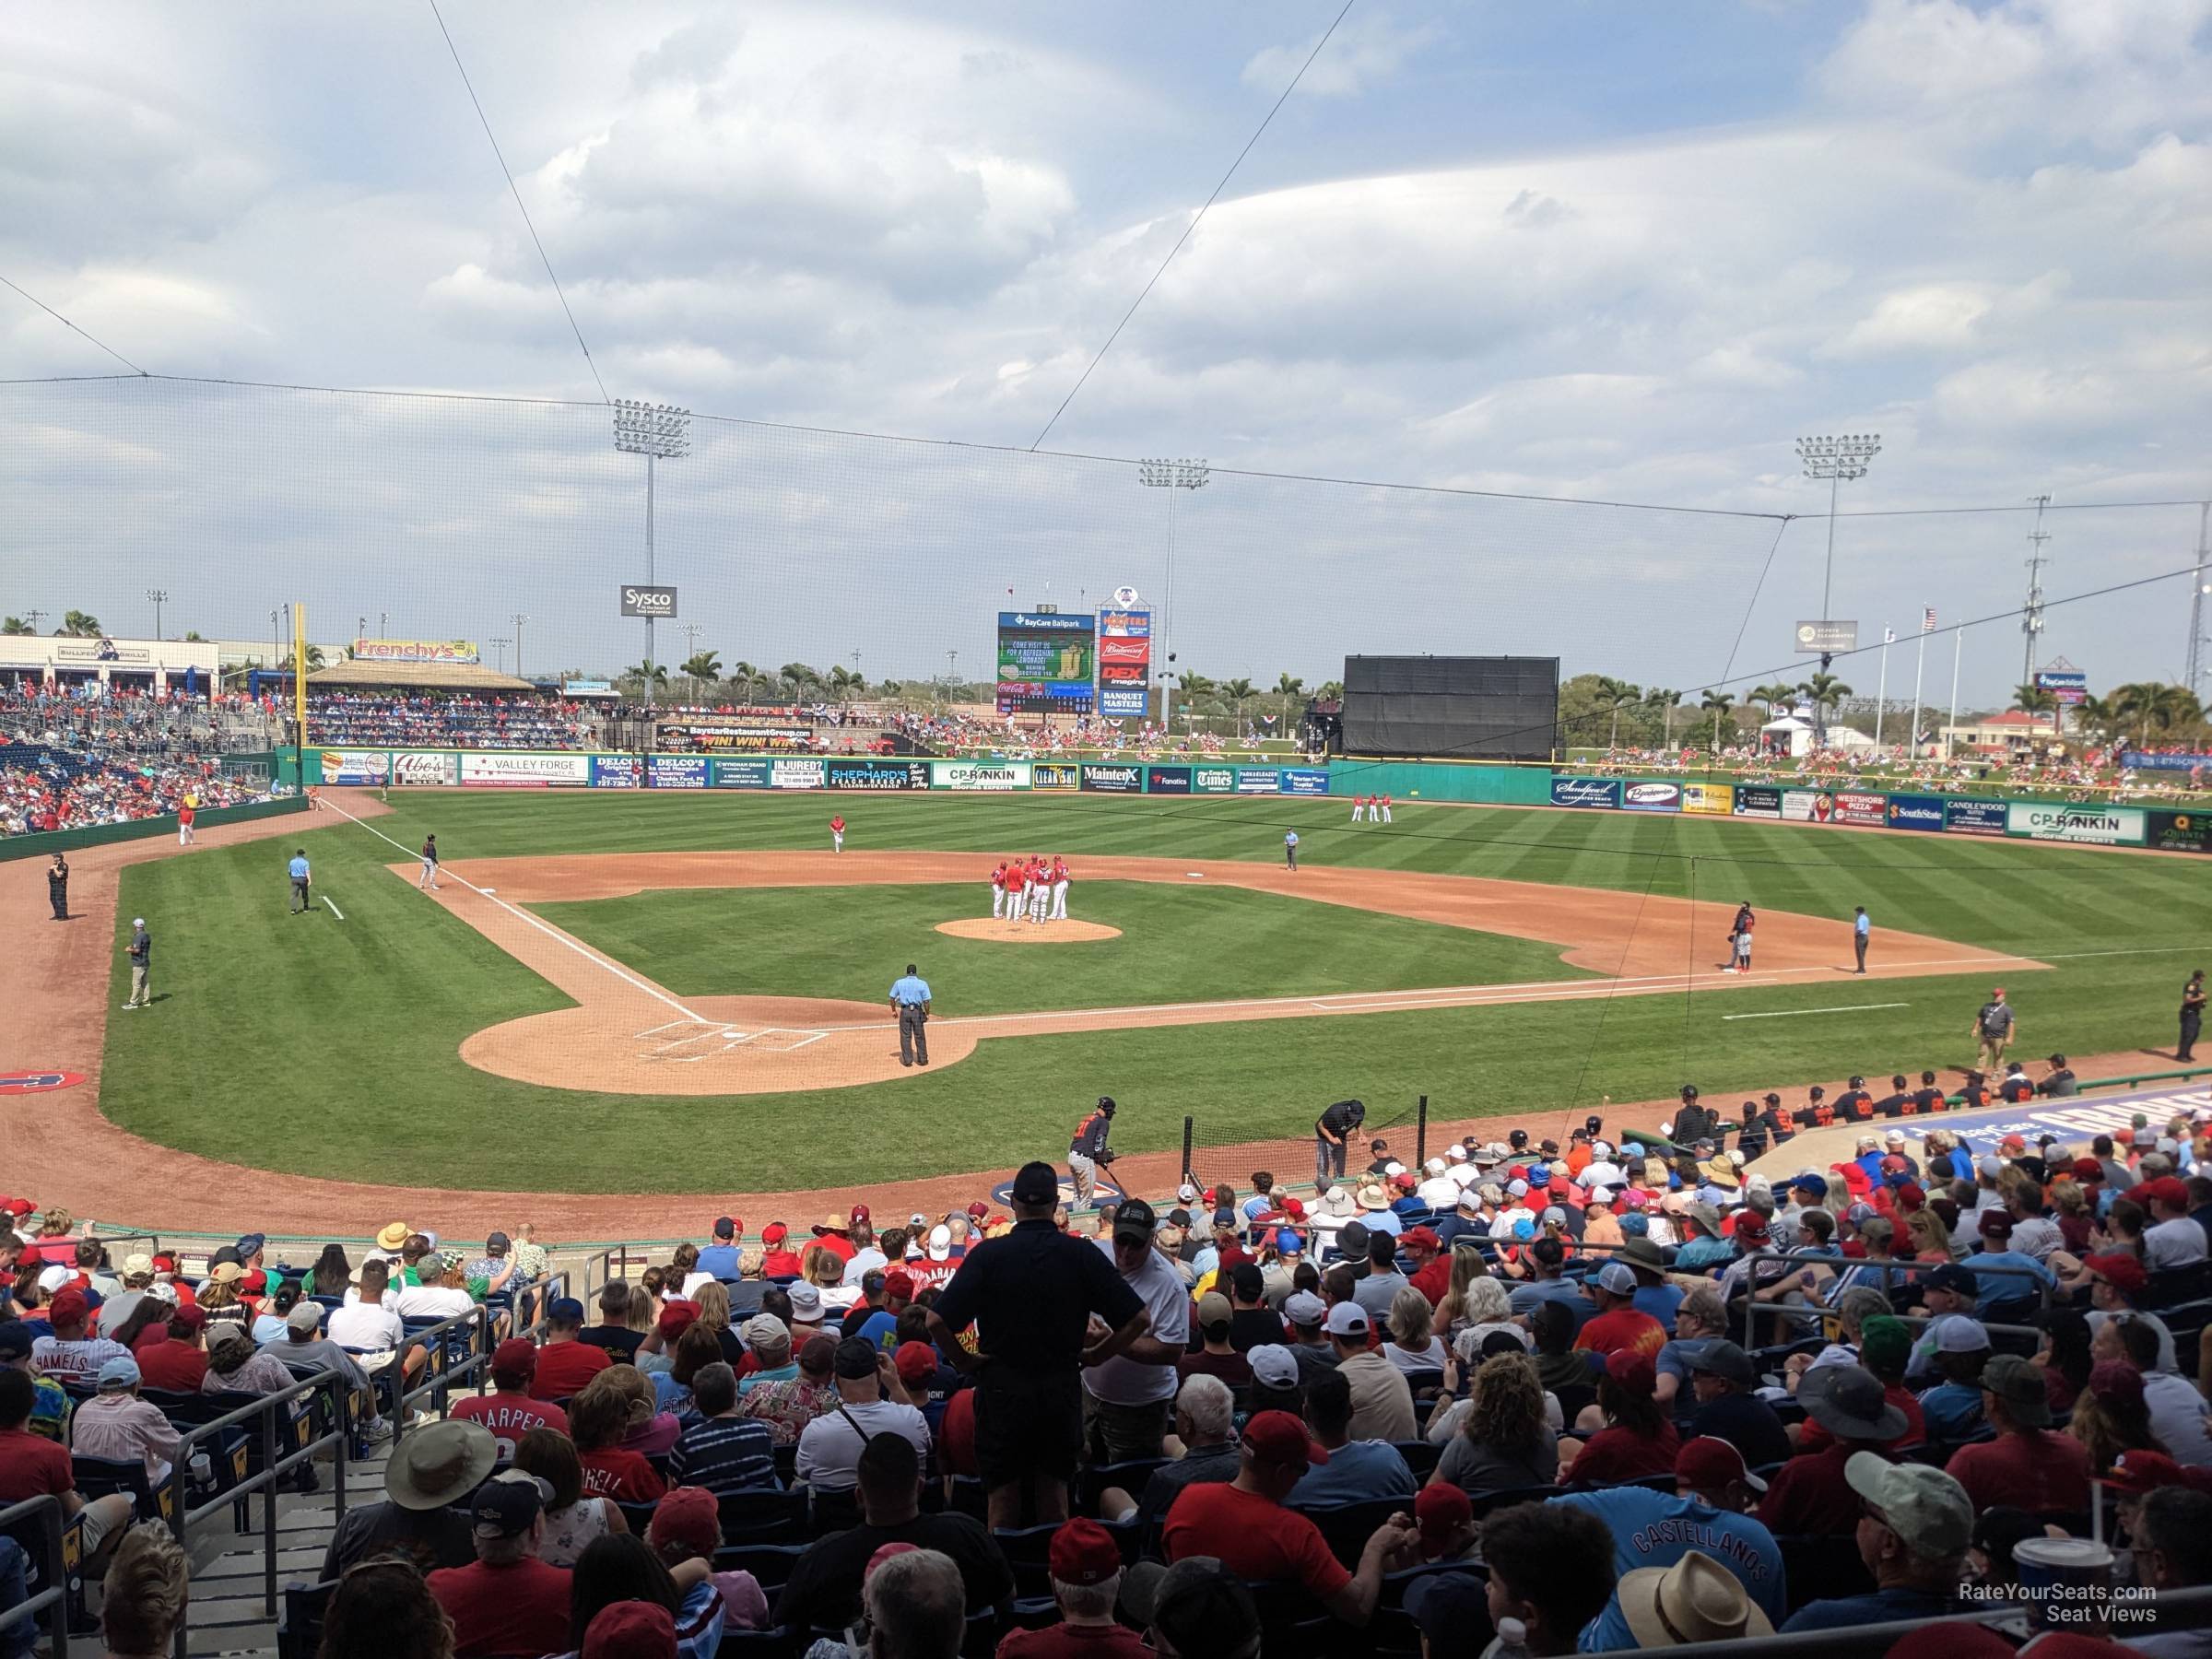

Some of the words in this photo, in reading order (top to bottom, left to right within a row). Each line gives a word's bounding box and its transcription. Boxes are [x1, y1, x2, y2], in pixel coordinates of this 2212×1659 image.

[626, 589, 671, 607] Sysco
[1025, 618, 1052, 628] BayCare
[1053, 620, 1079, 629] Ballpark
[357, 639, 455, 659] Frenchy's
[1106, 645, 1143, 654] Budweiser
[1102, 666, 1143, 679] DEX
[1112, 678, 1147, 687] imaging
[1103, 692, 1143, 700] BANQUET
[1103, 700, 1143, 708] MASTERS
[689, 726, 811, 738] BaystarRestaurantGroup.com
[702, 736, 734, 747] WIN!
[736, 737, 767, 747] WIN!
[395, 754, 443, 772] Abe's
[495, 760, 538, 770] VALLEY
[540, 760, 575, 771] FORGE
[656, 759, 705, 767] DELCO'S
[773, 760, 823, 771] INJURED?
[831, 770, 908, 780] SHEPHARD'S
[1035, 770, 1058, 785] CLEAR
[1062, 769, 1076, 785] SKY
[1084, 766, 1139, 783] MaintenX
[1197, 771, 1232, 786] Times
[1161, 777, 1187, 785] Fanatics
[1556, 780, 1616, 798] Sandpearl
[1847, 803, 1872, 811] PIZZA
[1947, 800, 2006, 812] CANDLEWOOD
[1899, 808, 1943, 820] SouthState
[2030, 831, 2071, 841] ROOFING
[2073, 834, 2115, 844] EXPERTS
[1955, 1122, 2041, 1139] BayCare
[470, 1407, 546, 1431] HARPER
[1631, 1519, 1770, 1583] CASTELLANOS
